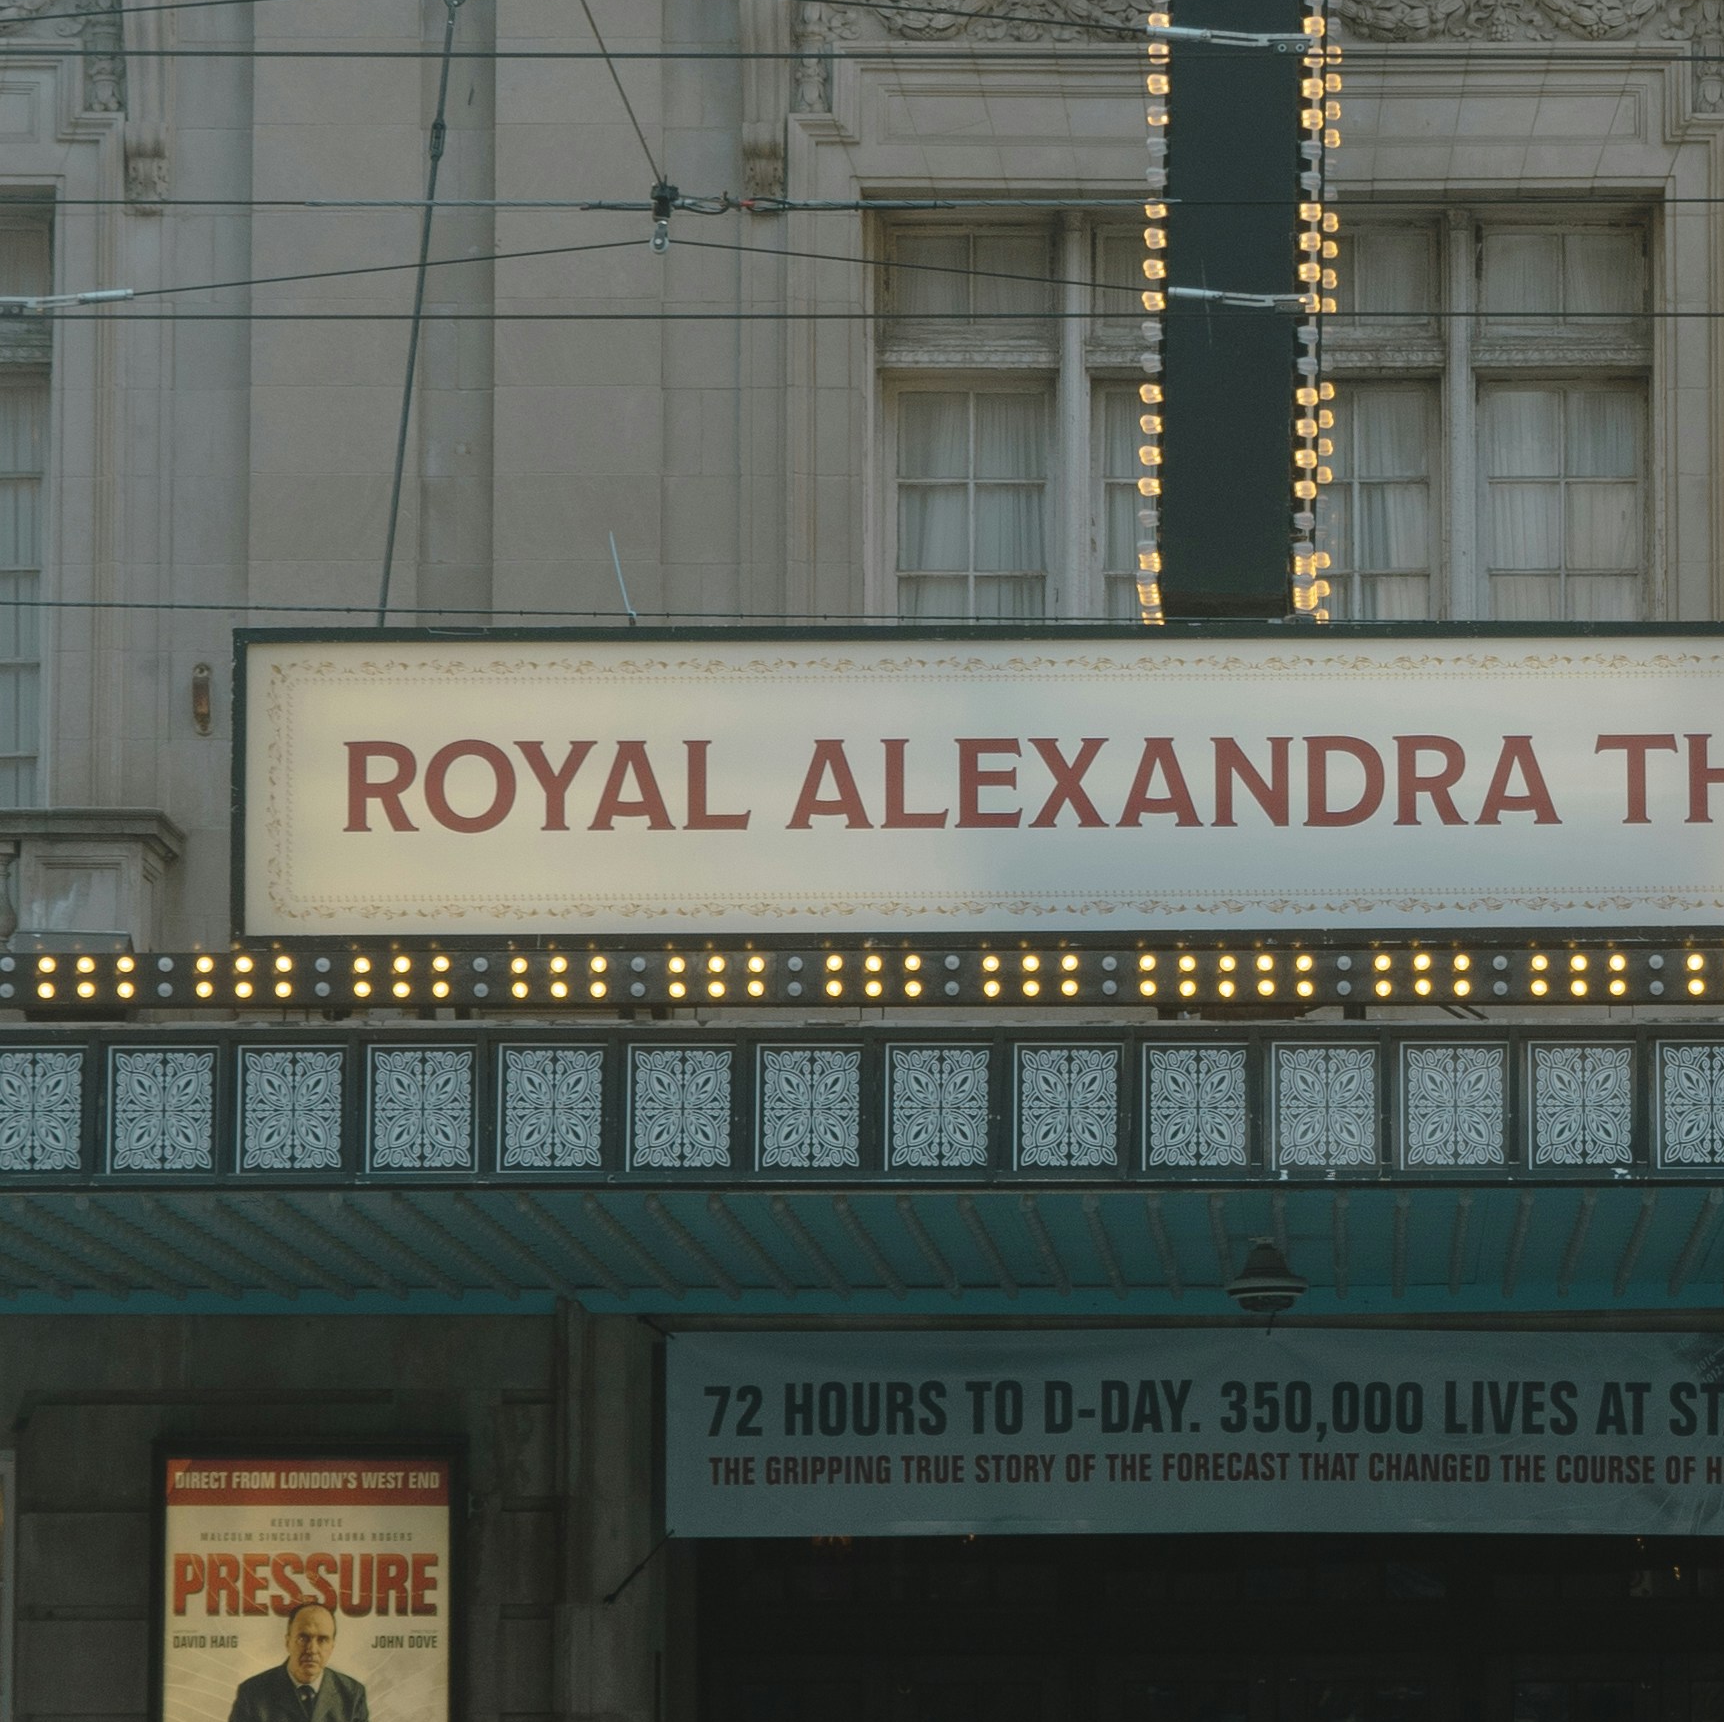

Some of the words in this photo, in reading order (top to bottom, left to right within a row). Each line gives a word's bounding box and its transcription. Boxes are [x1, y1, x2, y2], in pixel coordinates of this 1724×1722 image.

[342, 738, 752, 834] ROYAL
[786, 734, 1562, 832] ALEXANDRA
[704, 1384, 763, 1437] 72
[784, 1379, 947, 1437] HOURS
[966, 1379, 1023, 1436] TO
[1044, 1379, 1201, 1435] D-DAY.
[1220, 1380, 1424, 1442] 350,000
[1444, 1380, 1578, 1435] LIVES
[1596, 1380, 1652, 1436] AT
[175, 1471, 228, 1489] DIRECT
[232, 1471, 276, 1489] FROM
[280, 1471, 357, 1489] LONDON'S
[362, 1471, 405, 1489] WEST
[408, 1471, 440, 1489] END
[709, 1457, 755, 1486] THE
[765, 1456, 892, 1485] GRIPPING
[901, 1455, 966, 1484] TRUE
[975, 1454, 1057, 1483] STORY
[1065, 1453, 1097, 1482] OF
[1107, 1453, 1152, 1482] THE
[1162, 1452, 1289, 1482] FORECAST
[1298, 1452, 1359, 1481] THAT
[1368, 1454, 1490, 1483] CHANGED
[1499, 1455, 1546, 1483] THE
[1556, 1456, 1656, 1485] COURSE
[1665, 1456, 1697, 1485] OF
[173, 1552, 439, 1618] PRESSURE
[173, 1635, 207, 1649] DAVID
[210, 1635, 240, 1649] HAIG
[371, 1635, 405, 1649] JOHN
[408, 1635, 439, 1649] DOVE
